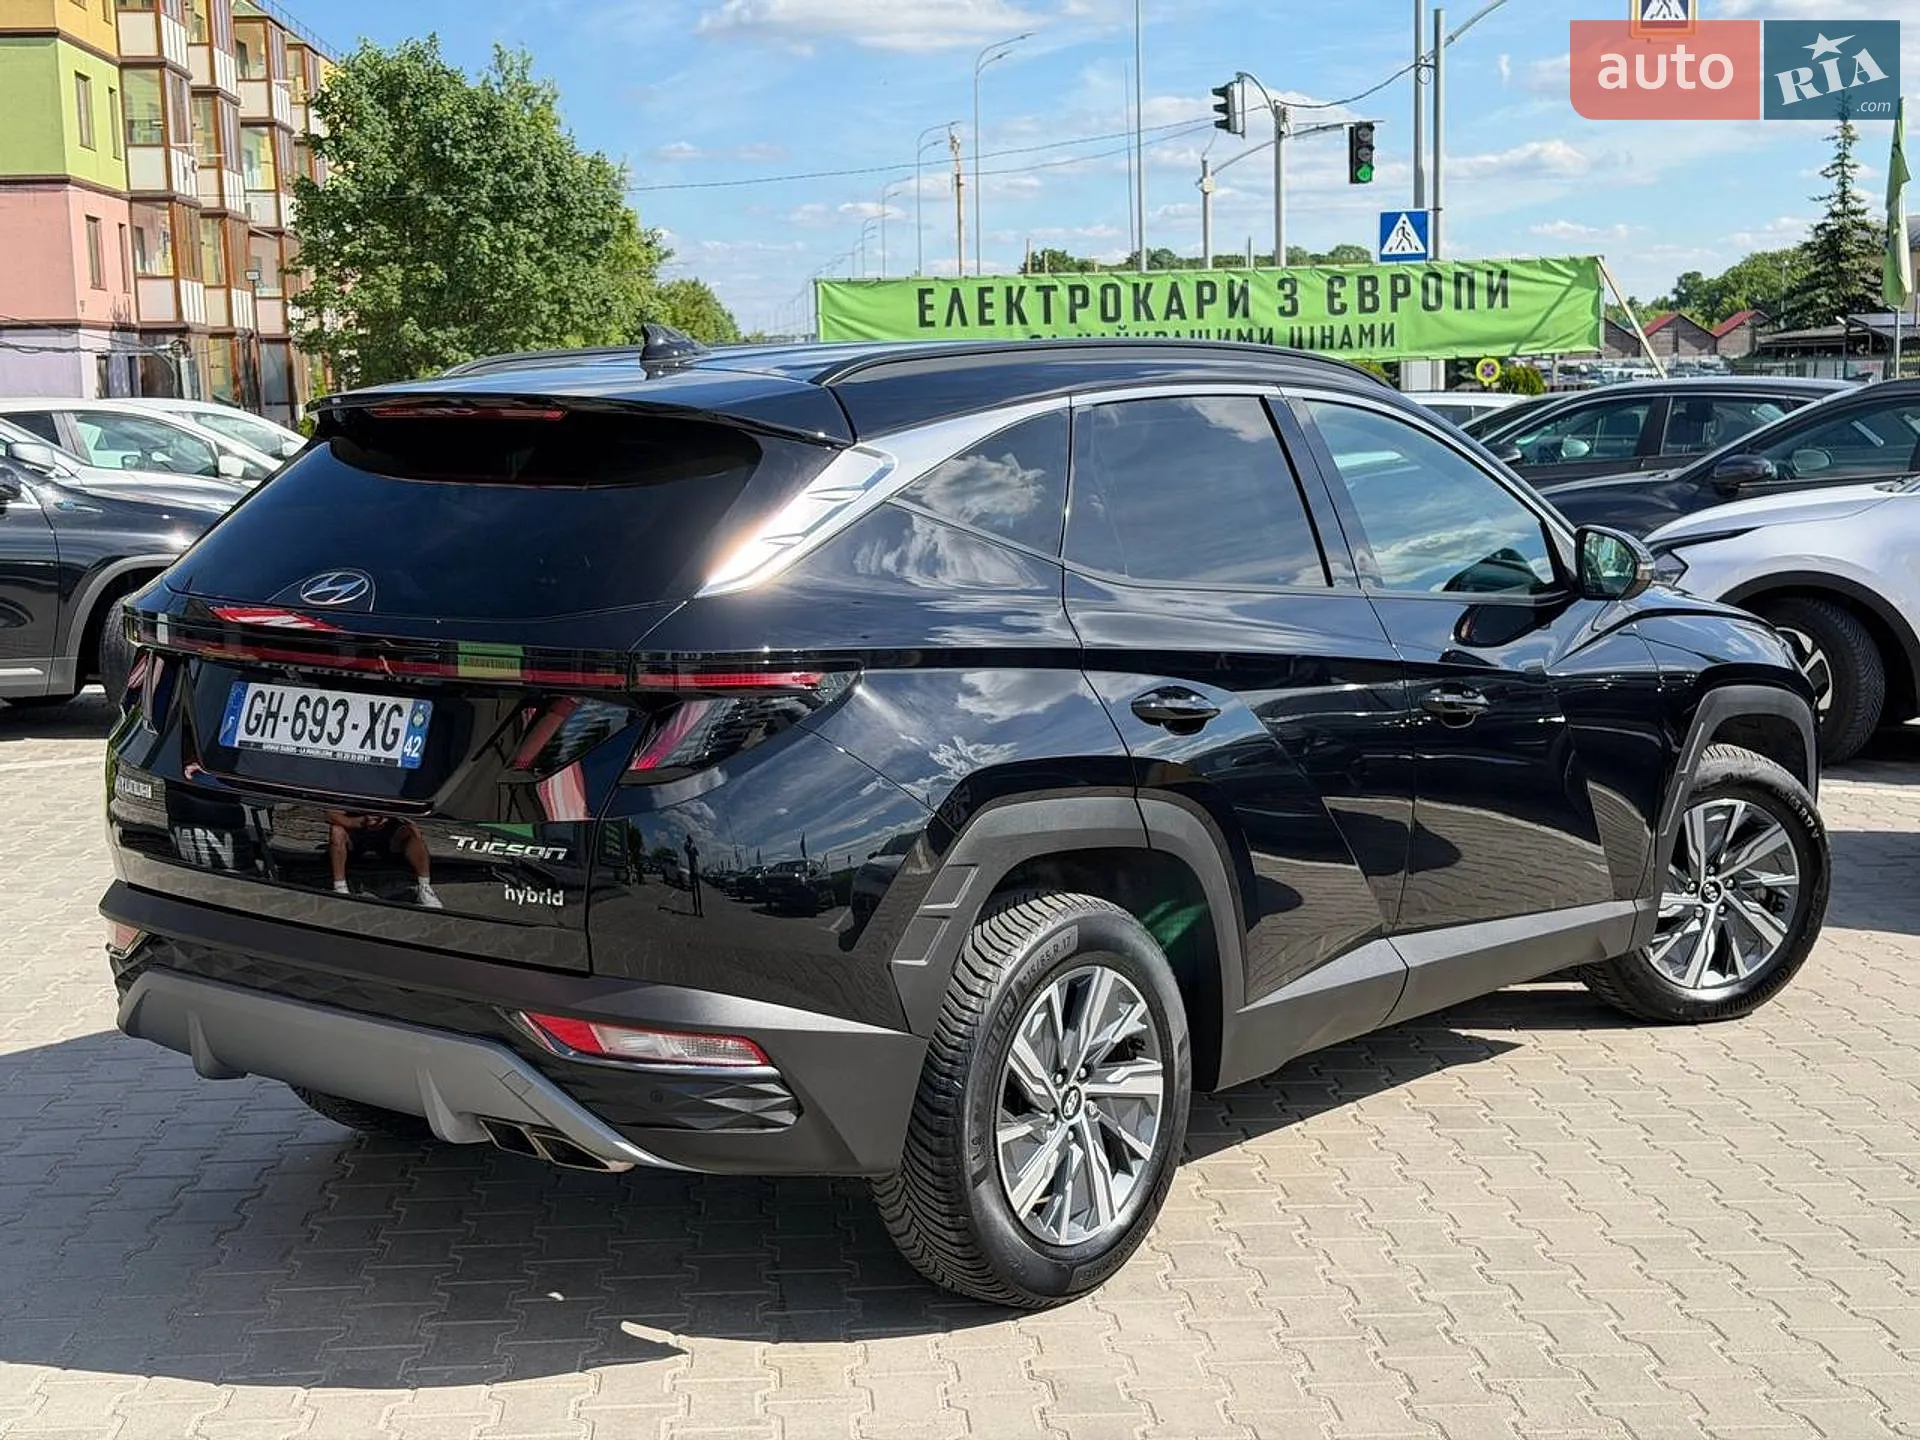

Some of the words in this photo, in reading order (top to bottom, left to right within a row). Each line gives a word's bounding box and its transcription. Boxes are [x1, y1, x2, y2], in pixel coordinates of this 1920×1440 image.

[917, 280, 1251, 328] ЕЛЕКТРОКАРИ
[1277, 278, 1299, 317] З
[1327, 269, 1510, 316] ЄВРОПИ
[1290, 322, 1396, 350] ЦІНАМИ
[244, 689, 404, 752] GH-693-XG
[404, 735, 422, 758] 42
[504, 883, 564, 907] hybrid
